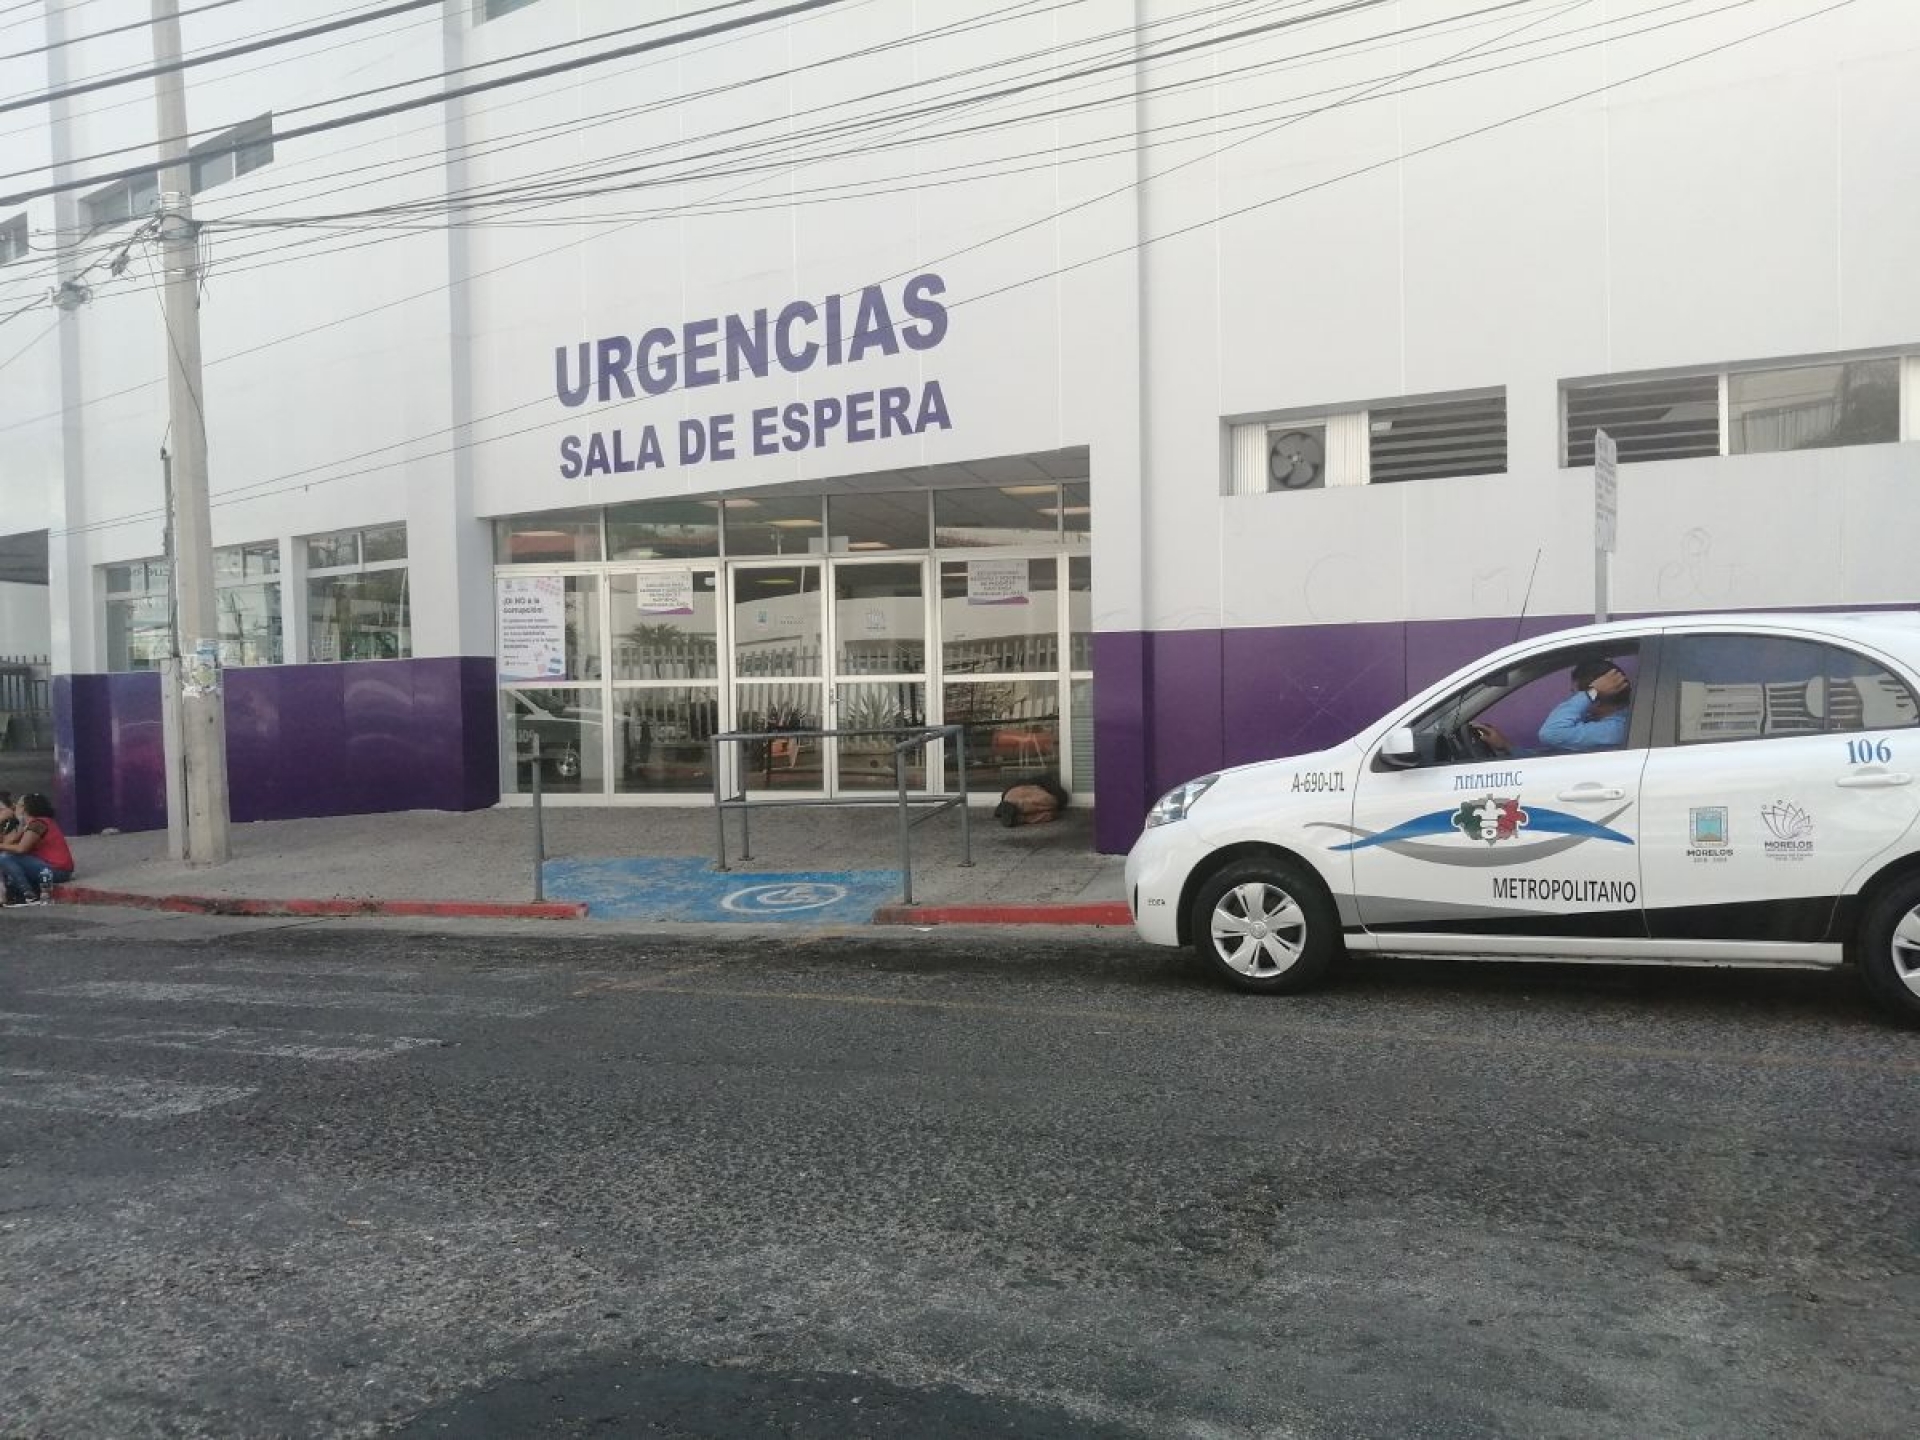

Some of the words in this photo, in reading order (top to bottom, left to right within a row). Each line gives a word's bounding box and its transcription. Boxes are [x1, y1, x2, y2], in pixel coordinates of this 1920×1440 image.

[555, 273, 948, 407] URGENCIAS
[560, 425, 665, 479] SALA
[679, 413, 735, 466] DE
[753, 380, 952, 457] ESPERA
[1847, 738, 1891, 764] 106
[1291, 772, 1345, 793] A-690-LTL
[1454, 770, 1523, 790] ANAHUAC
[1686, 849, 1734, 857] MORELOS
[1764, 841, 1813, 849] MORELOS
[1493, 877, 1636, 903] METROPOLITANO
